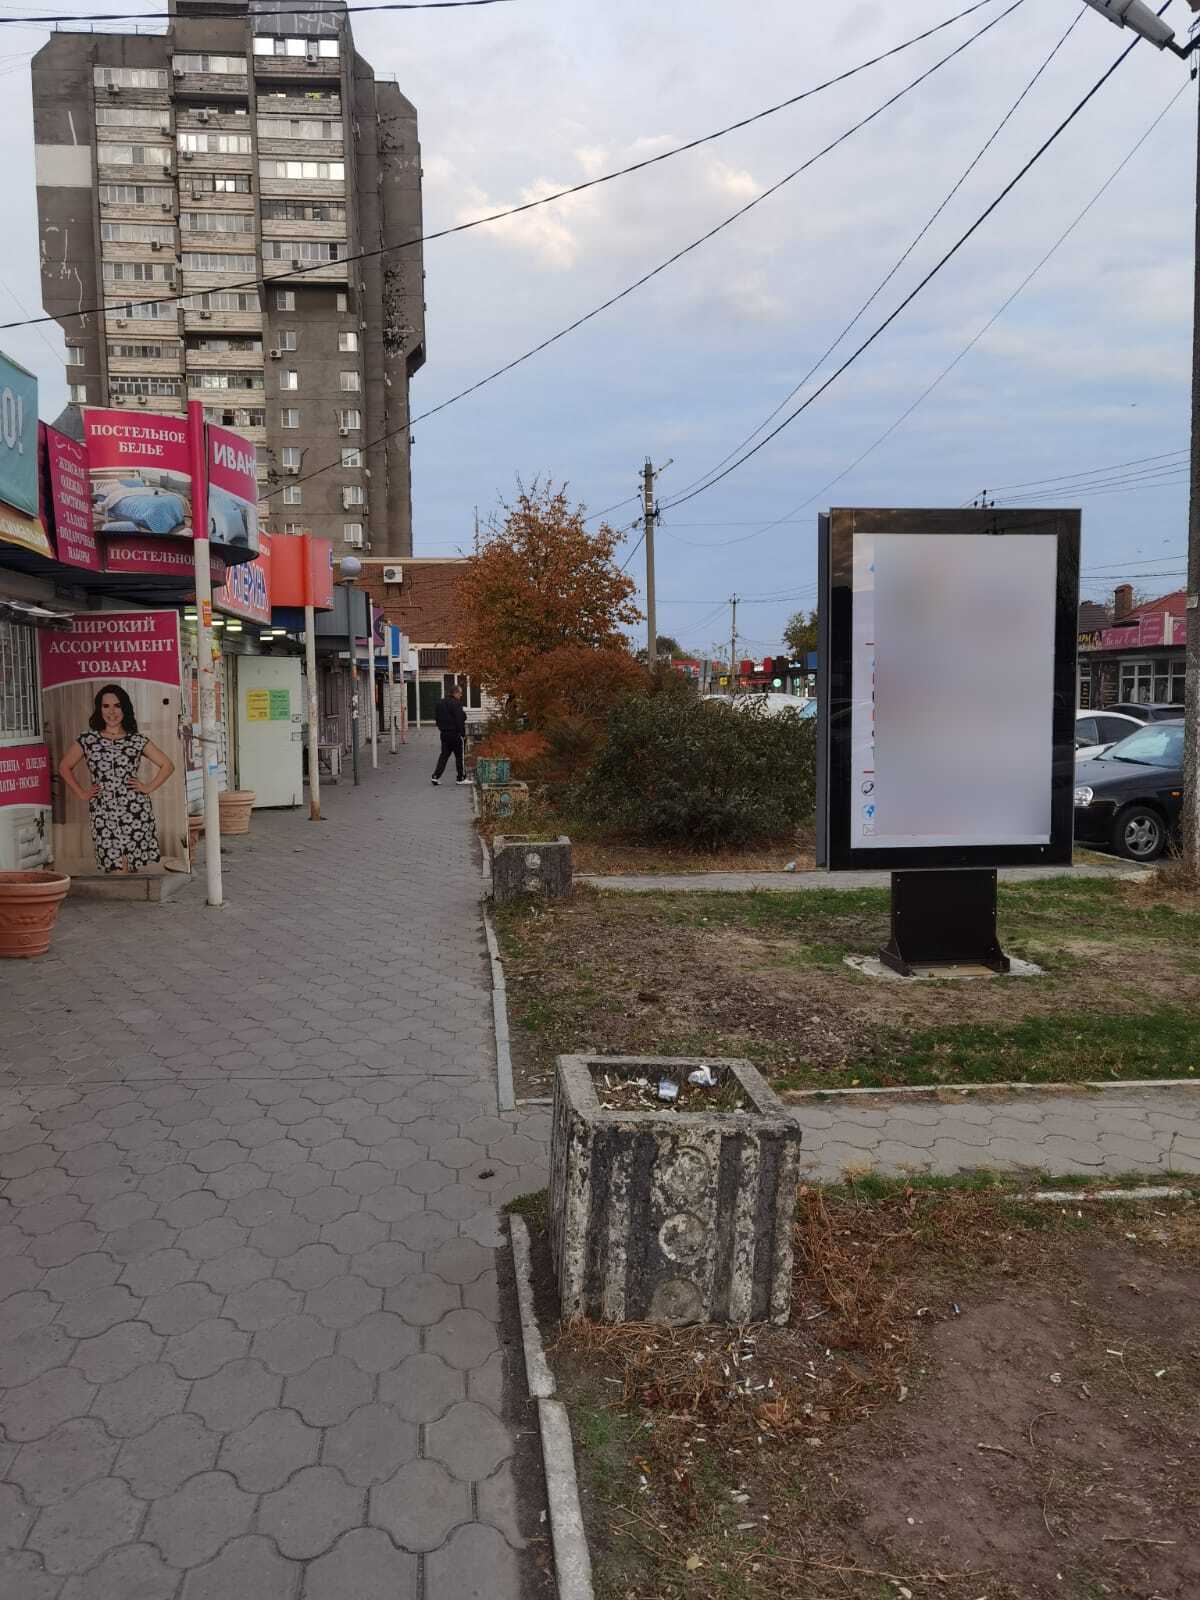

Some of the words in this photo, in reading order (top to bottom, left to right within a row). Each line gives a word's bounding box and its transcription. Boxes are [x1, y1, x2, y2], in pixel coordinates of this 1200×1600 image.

[0, 386, 24, 456] О!
[90, 424, 186, 443] ПОСТЕЛЬНОЕ
[118, 442, 165, 456] БЕЛЬЕ
[109, 548, 195, 566] ПОСТЕЛЬНО
[49, 639, 174, 653] АССОРТИМЕНТ
[78, 660, 147, 673] ТОВАРА!
